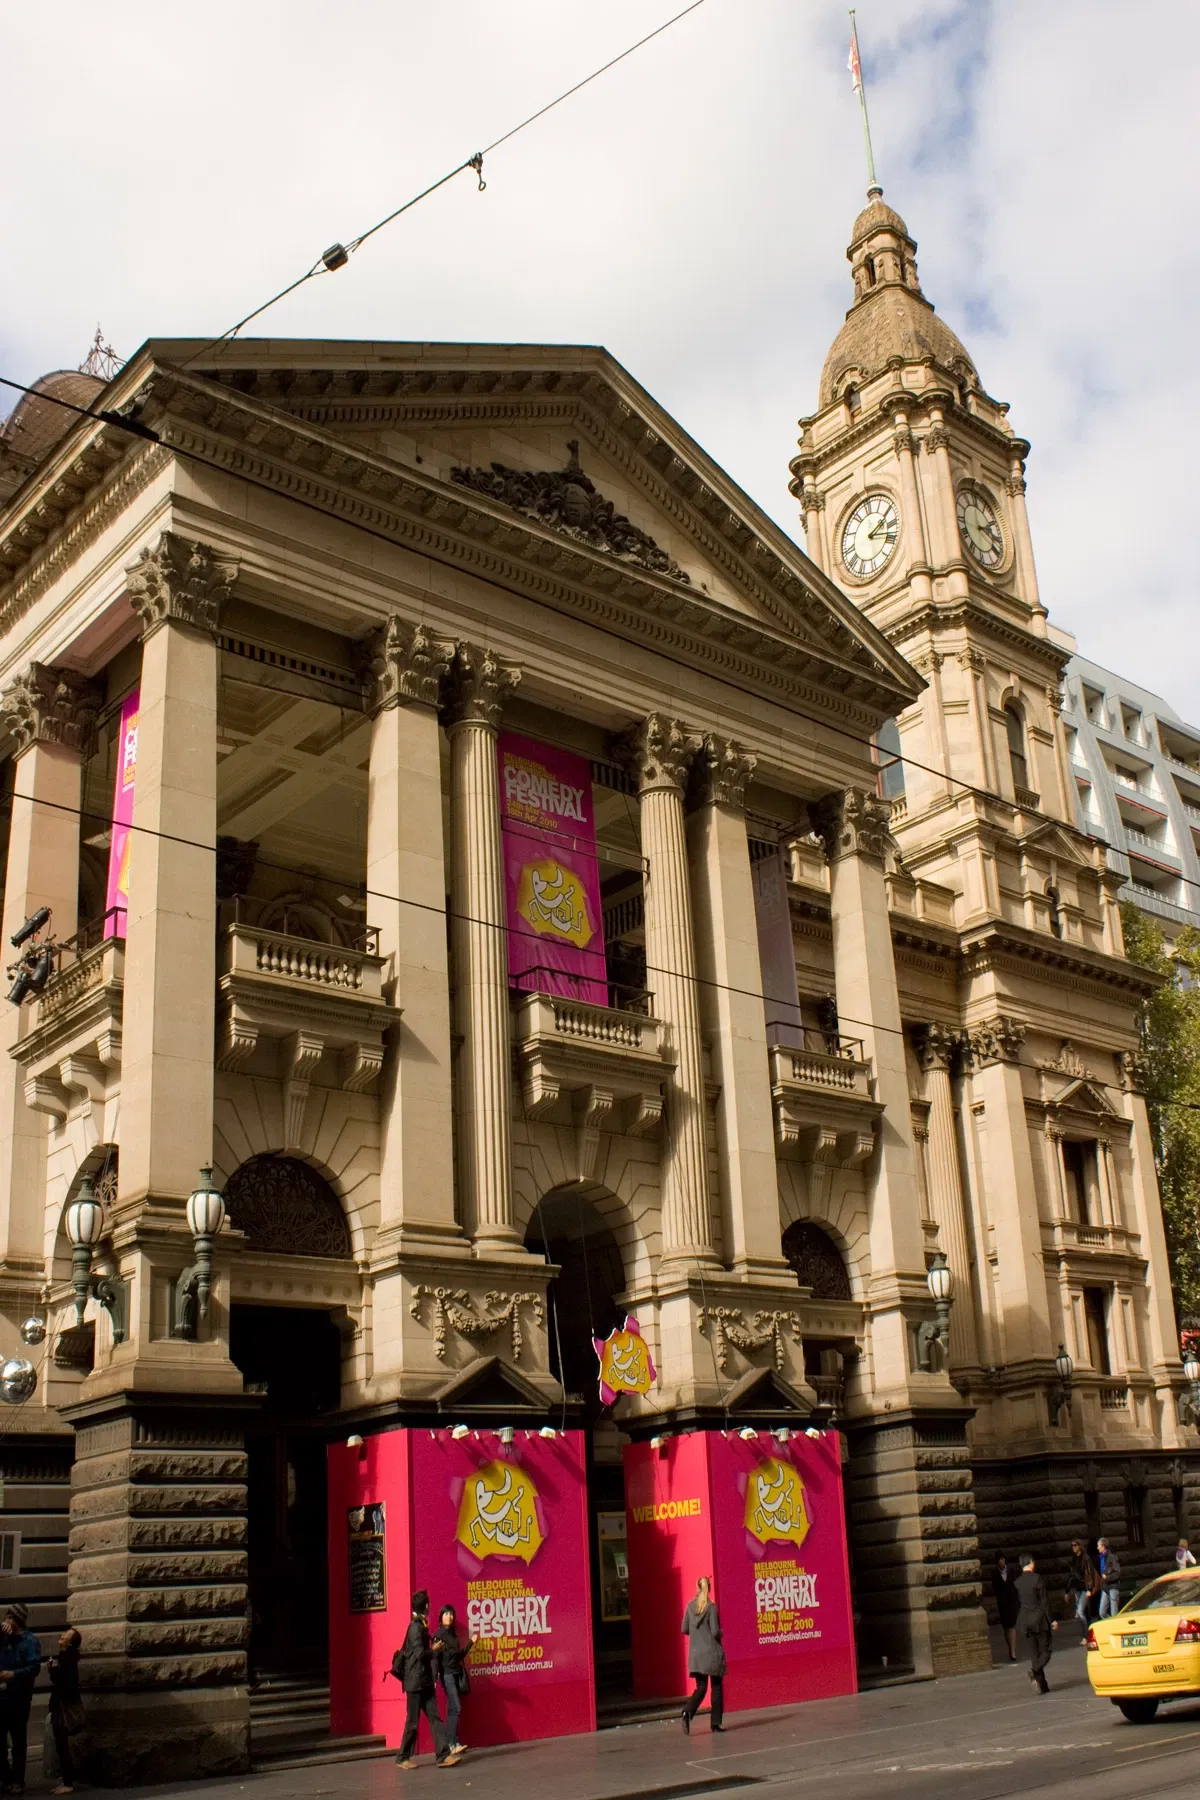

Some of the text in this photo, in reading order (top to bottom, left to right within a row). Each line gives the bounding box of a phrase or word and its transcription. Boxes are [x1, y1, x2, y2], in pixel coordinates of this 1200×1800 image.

[504, 765, 584, 803] COMEDY
[505, 780, 587, 823] FESTIVAL
[540, 817, 558, 829] 2010
[632, 1498, 702, 1523] WELCOME!
[755, 1560, 796, 1570] MELBOURNE
[755, 1567, 806, 1579] INTERNATIONAL
[467, 1579, 523, 1590] MELBOURNE
[755, 1574, 817, 1596] COMEDY
[468, 1588, 536, 1600] INTERNATIONAL
[756, 1591, 820, 1613] FESTIVAL
[467, 1595, 551, 1621] COMEDY
[757, 1611, 776, 1623] 24th
[469, 1615, 552, 1640] FESTIVAL
[758, 1618, 814, 1634] 18th Apr 2010
[758, 1631, 821, 1644] comedyfestival.com.au
[1132, 1636, 1147, 1645] 4770
[470, 1646, 543, 1664] 18th Apr 2010
[470, 1660, 553, 1676] comedyfestival.com.au
